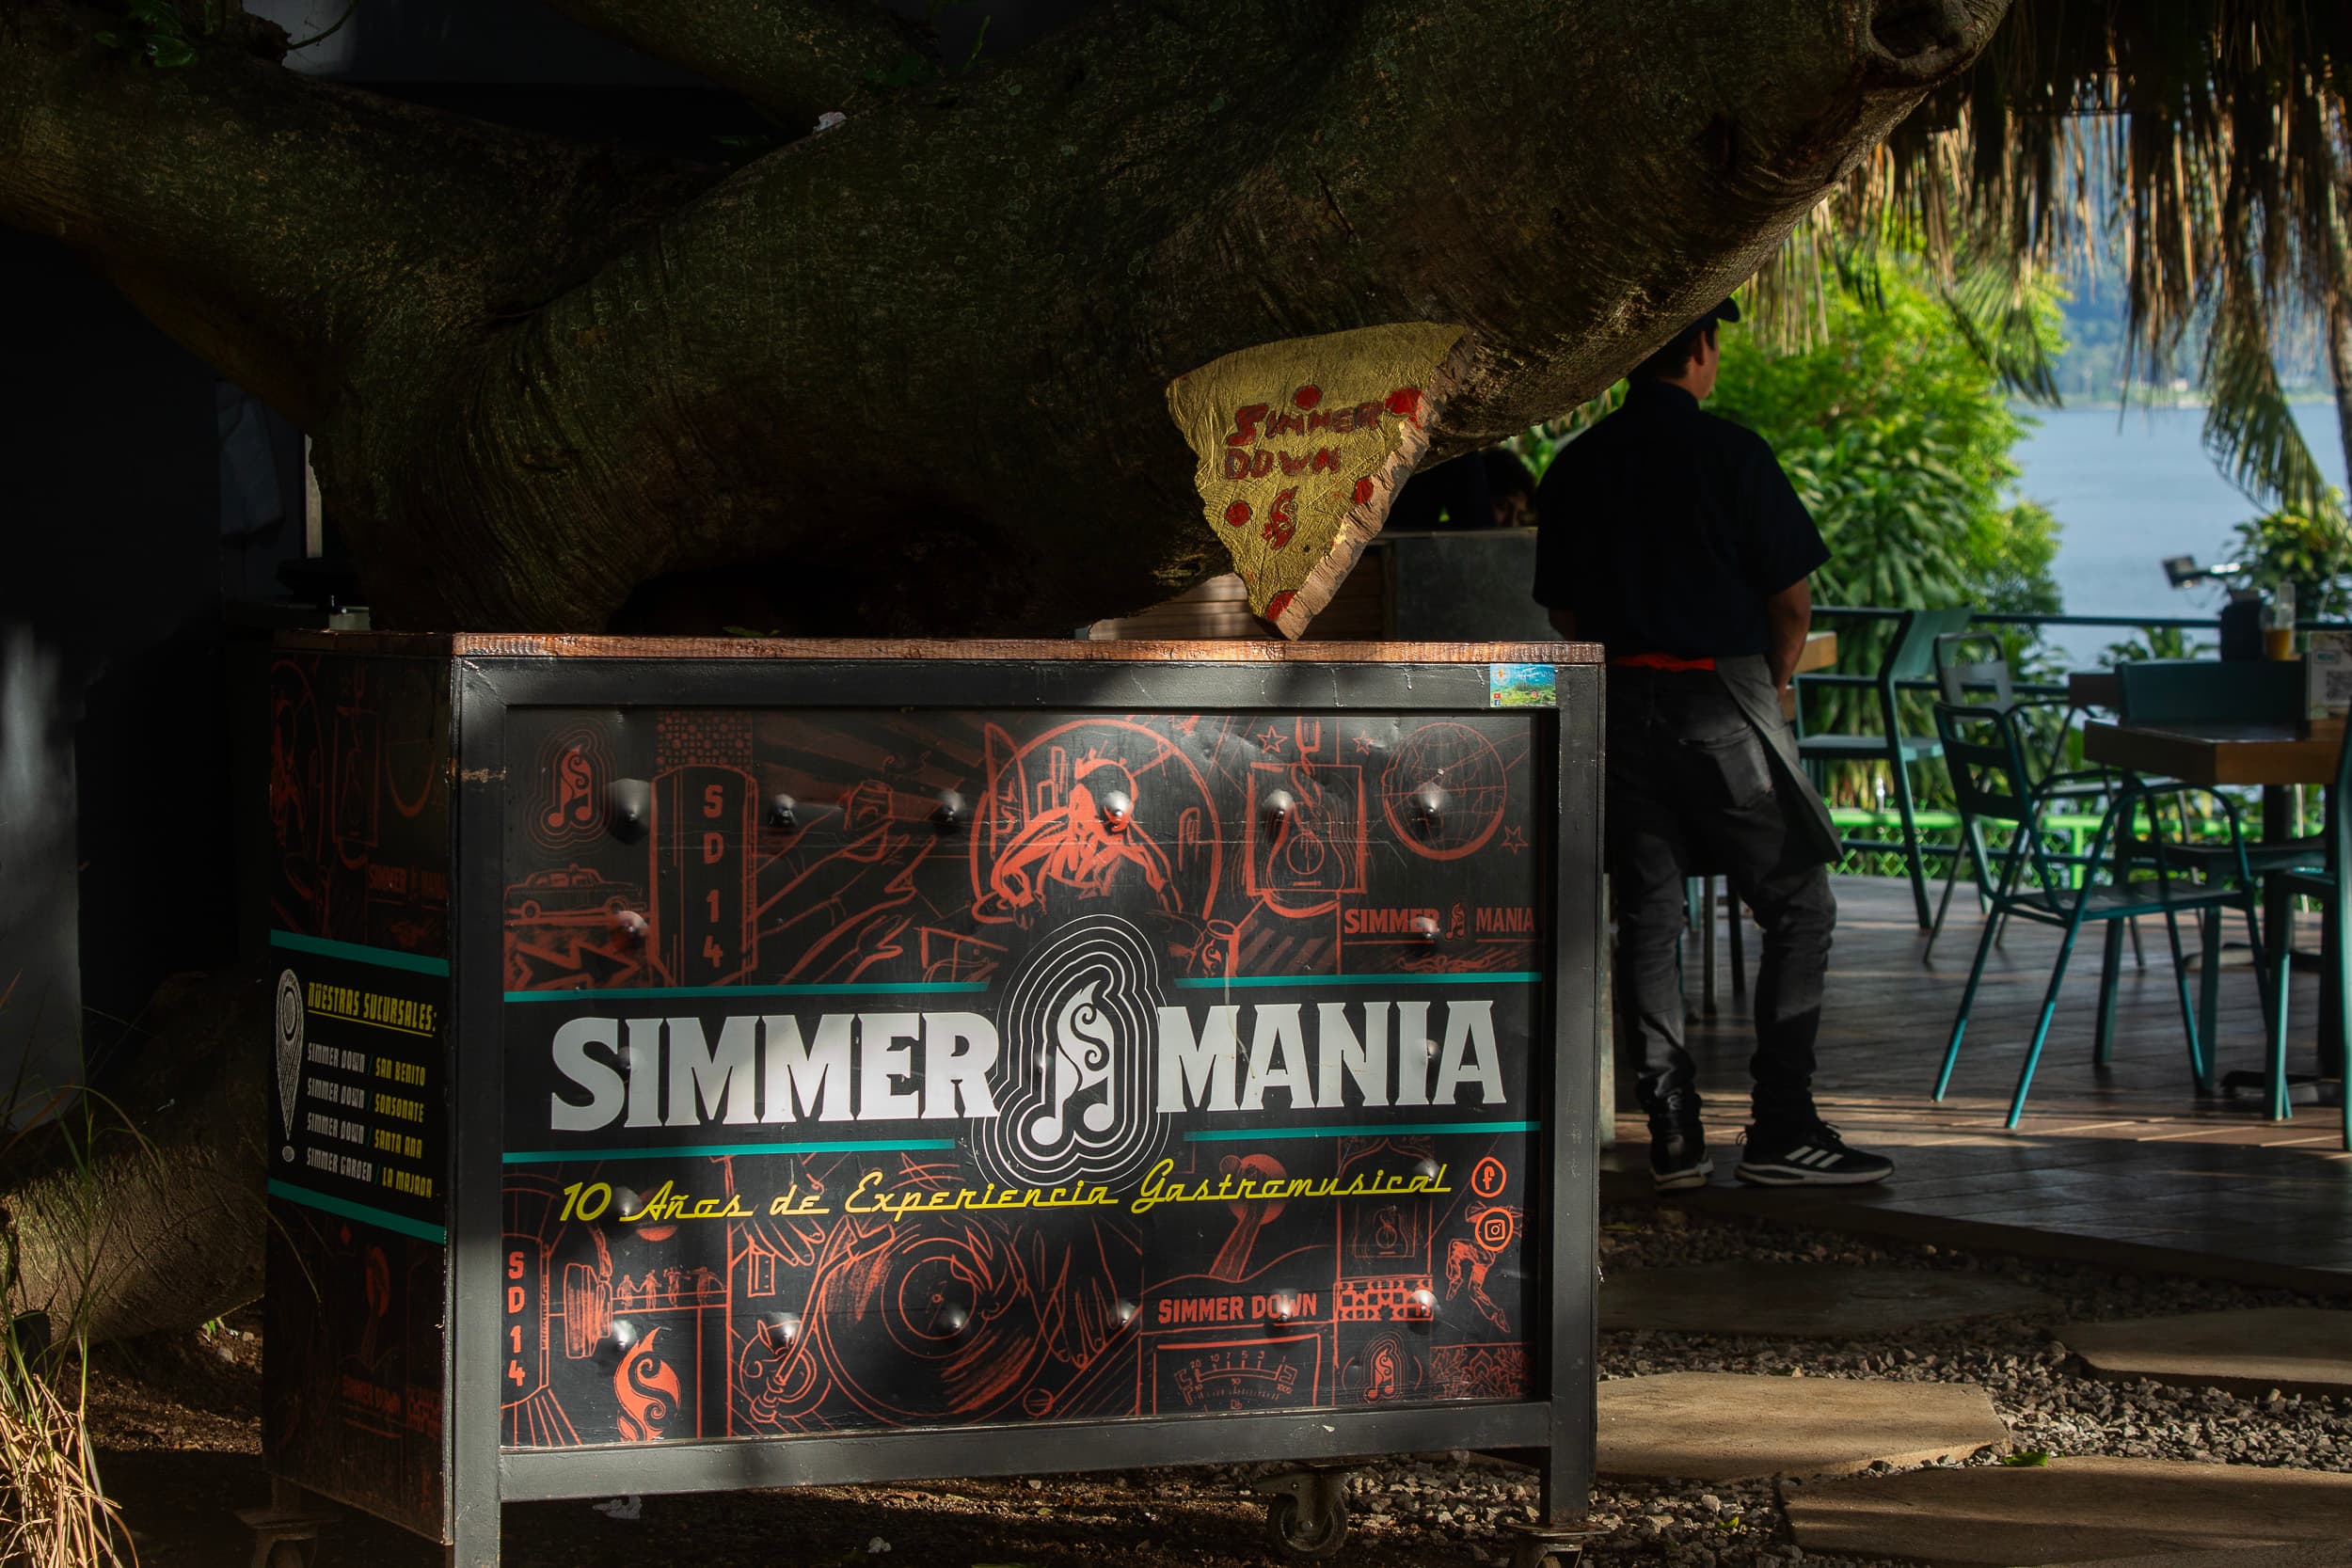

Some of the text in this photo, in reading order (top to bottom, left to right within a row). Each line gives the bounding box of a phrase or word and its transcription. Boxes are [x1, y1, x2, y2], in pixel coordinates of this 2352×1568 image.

[1227, 402, 1384, 447] SIMMER
[1225, 447, 1340, 480] DOWN
[1343, 907, 1536, 934] SIMMER MANIA
[307, 981, 437, 1033] NUESTRAS SUCURSALES:
[307, 1041, 427, 1087] SIMMER DOWN SAN BENITO
[550, 999, 1507, 1132] SIMMER MANIA
[307, 1076, 425, 1124] SIMMER DOWN SONSONATE
[306, 1111, 422, 1160] SIMMER DOWN SANTA ANA
[306, 1146, 339, 1174] SIMMER
[340, 1155, 373, 1182] GARDEN
[382, 1166, 394, 1189] LA
[560, 1181, 612, 1222] 10
[769, 1185, 830, 1216] de
[1158, 1292, 1317, 1324] SIMMER DOWN
